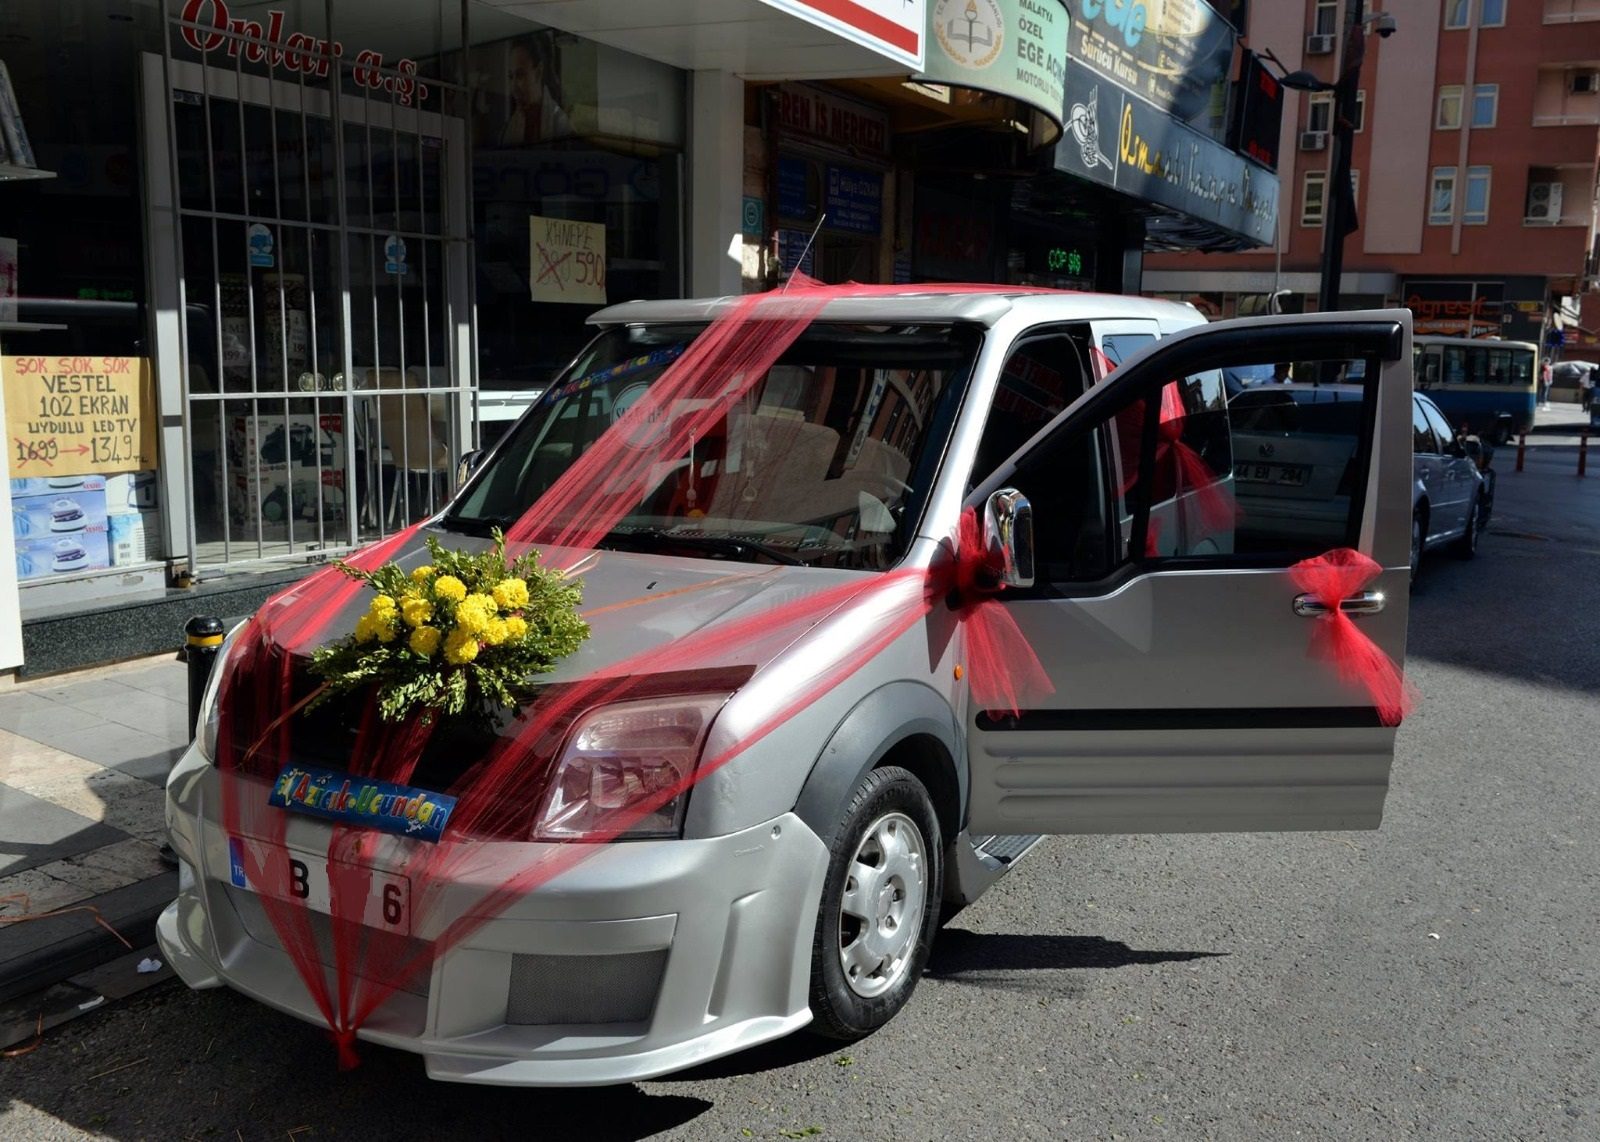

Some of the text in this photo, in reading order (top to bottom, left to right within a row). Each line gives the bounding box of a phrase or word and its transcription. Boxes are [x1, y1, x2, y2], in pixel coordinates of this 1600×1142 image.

[1018, 0, 1053, 25] MALATYA
[181, 0, 343, 77] Onlar
[1018, 14, 1044, 40] ÖZEL
[1017, 37, 1044, 67] EGE
[1080, 34, 1112, 70] Sürücü
[1113, 55, 1138, 85] Kursu
[545, 219, 593, 250] KANEPE
[575, 251, 604, 288] 590
[1407, 294, 1488, 320] Agresif
[41, 375, 116, 393] VESTEL
[39, 395, 129, 418] 102 EKRAN
[28, 418, 137, 434] UYDULU LED TV
[16, 439, 58, 461] 1699
[90, 435, 132, 464] 1349
[357, 784, 448, 829] Ucundan
[234, 864, 244, 877] TR
